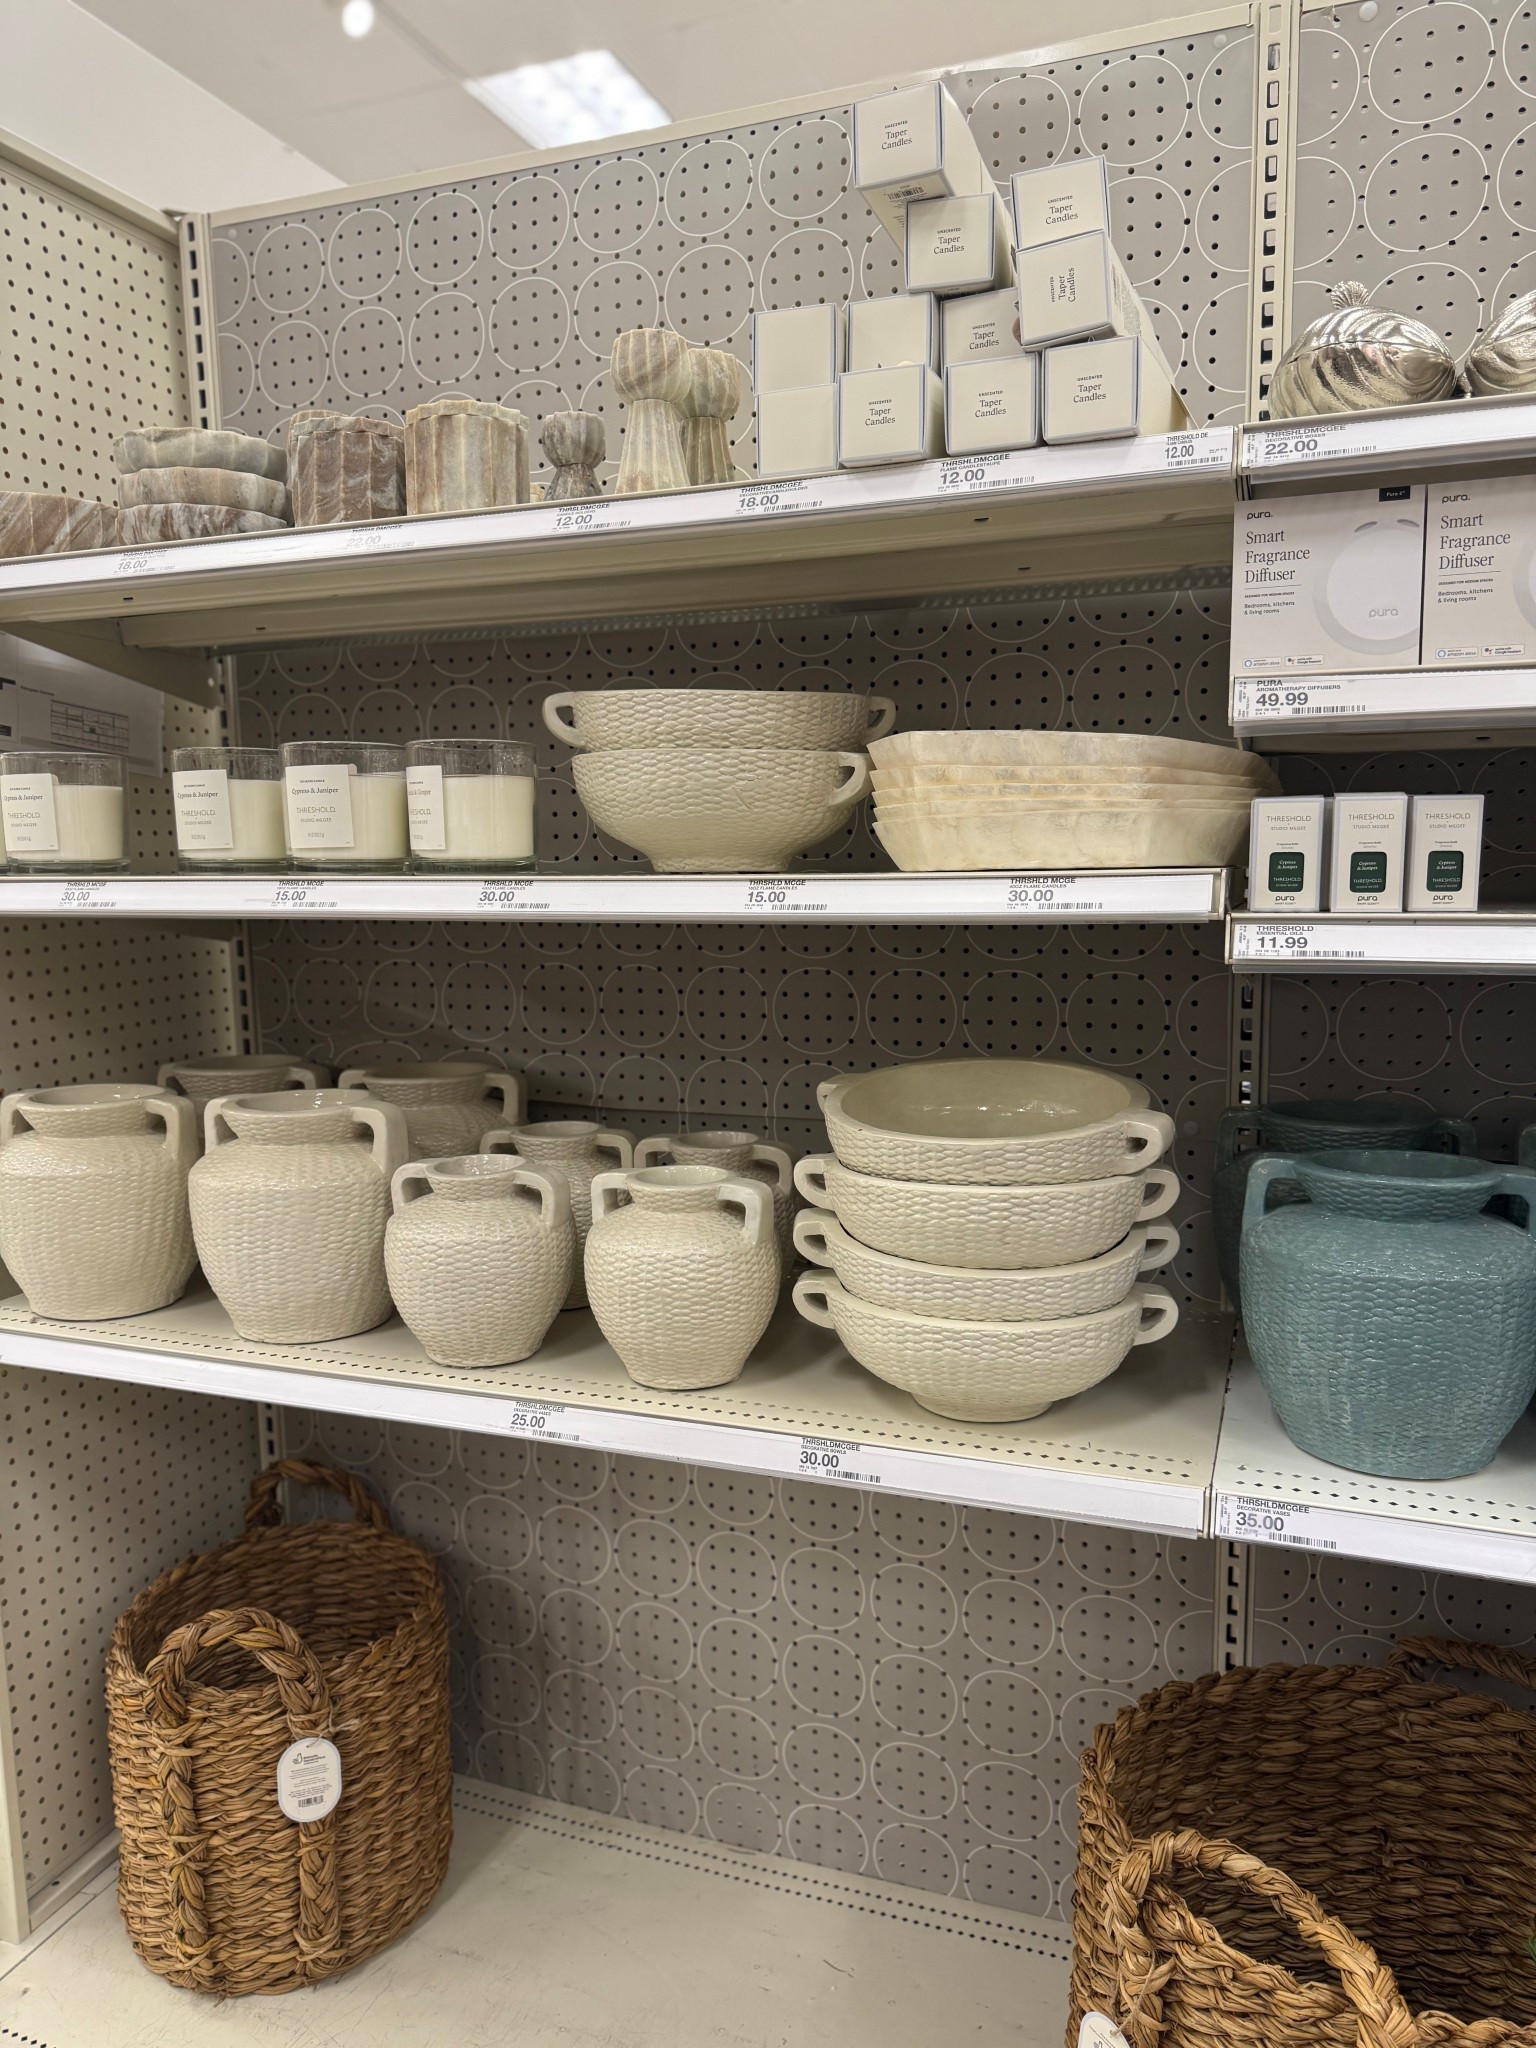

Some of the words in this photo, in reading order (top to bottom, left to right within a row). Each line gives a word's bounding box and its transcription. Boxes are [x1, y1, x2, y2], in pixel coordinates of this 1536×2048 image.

[885, 129, 908, 140] Taper
[881, 138, 913, 150] Candles
[1049, 203, 1073, 214] Taper
[1045, 212, 1079, 225] Candles
[938, 236, 961, 245] Taper
[933, 244, 965, 255] Candles
[1058, 275, 1066, 301] Taper
[1068, 267, 1076, 303] Candles
[973, 331, 995, 340] Taper
[969, 339, 1000, 350] Candles
[1077, 382, 1102, 393] Taper
[979, 398, 1003, 408] Taper
[1073, 391, 1107, 404] Candles
[869, 406, 892, 417] Taper
[974, 407, 1007, 418] Candles
[864, 415, 896, 426] Candles
[1266, 425, 1346, 438] THRSHLDMCGEE
[1265, 434, 1304, 443] DECORATIVE
[1165, 445, 1194, 459] 12.00
[1264, 439, 1318, 456] 22.00
[941, 453, 1011, 468] THRSHLDMCGEE
[940, 468, 985, 485] 12.00
[739, 494, 779, 508] 18.00
[556, 514, 592, 527] 12.00
[1440, 513, 1483, 530] Smart
[1246, 530, 1285, 545] Smart
[1439, 533, 1511, 552] Fragrance
[1245, 549, 1310, 566] Fragrance
[1439, 553, 1495, 570] Diffuser
[118, 559, 148, 570] 18.00
[1244, 567, 1296, 583] Diffuser
[1368, 608, 1399, 619] pura
[1256, 679, 1283, 687] PURA
[1255, 692, 1309, 707] 49.99
[1348, 813, 1395, 821] THRESHOLD
[61, 891, 90, 901] 30.00
[275, 891, 306, 901] 15.00
[479, 891, 515, 902] 30.00
[747, 891, 786, 903] 15.00
[1008, 889, 1054, 902] 30.00
[1257, 936, 1308, 949] 11.99
[516, 1401, 565, 1413] THRSHLDMCGEE
[511, 1413, 545, 1429] 25.00
[801, 1437, 861, 1452] THRSHLDMCGEE
[801, 1445, 829, 1453] DECORATIVE
[800, 1451, 839, 1468] 30.00
[1236, 1497, 1310, 1514] THRSHLDMCGEE
[1236, 1505, 1272, 1514] DECORATIVE
[1236, 1512, 1284, 1531] 35.00
